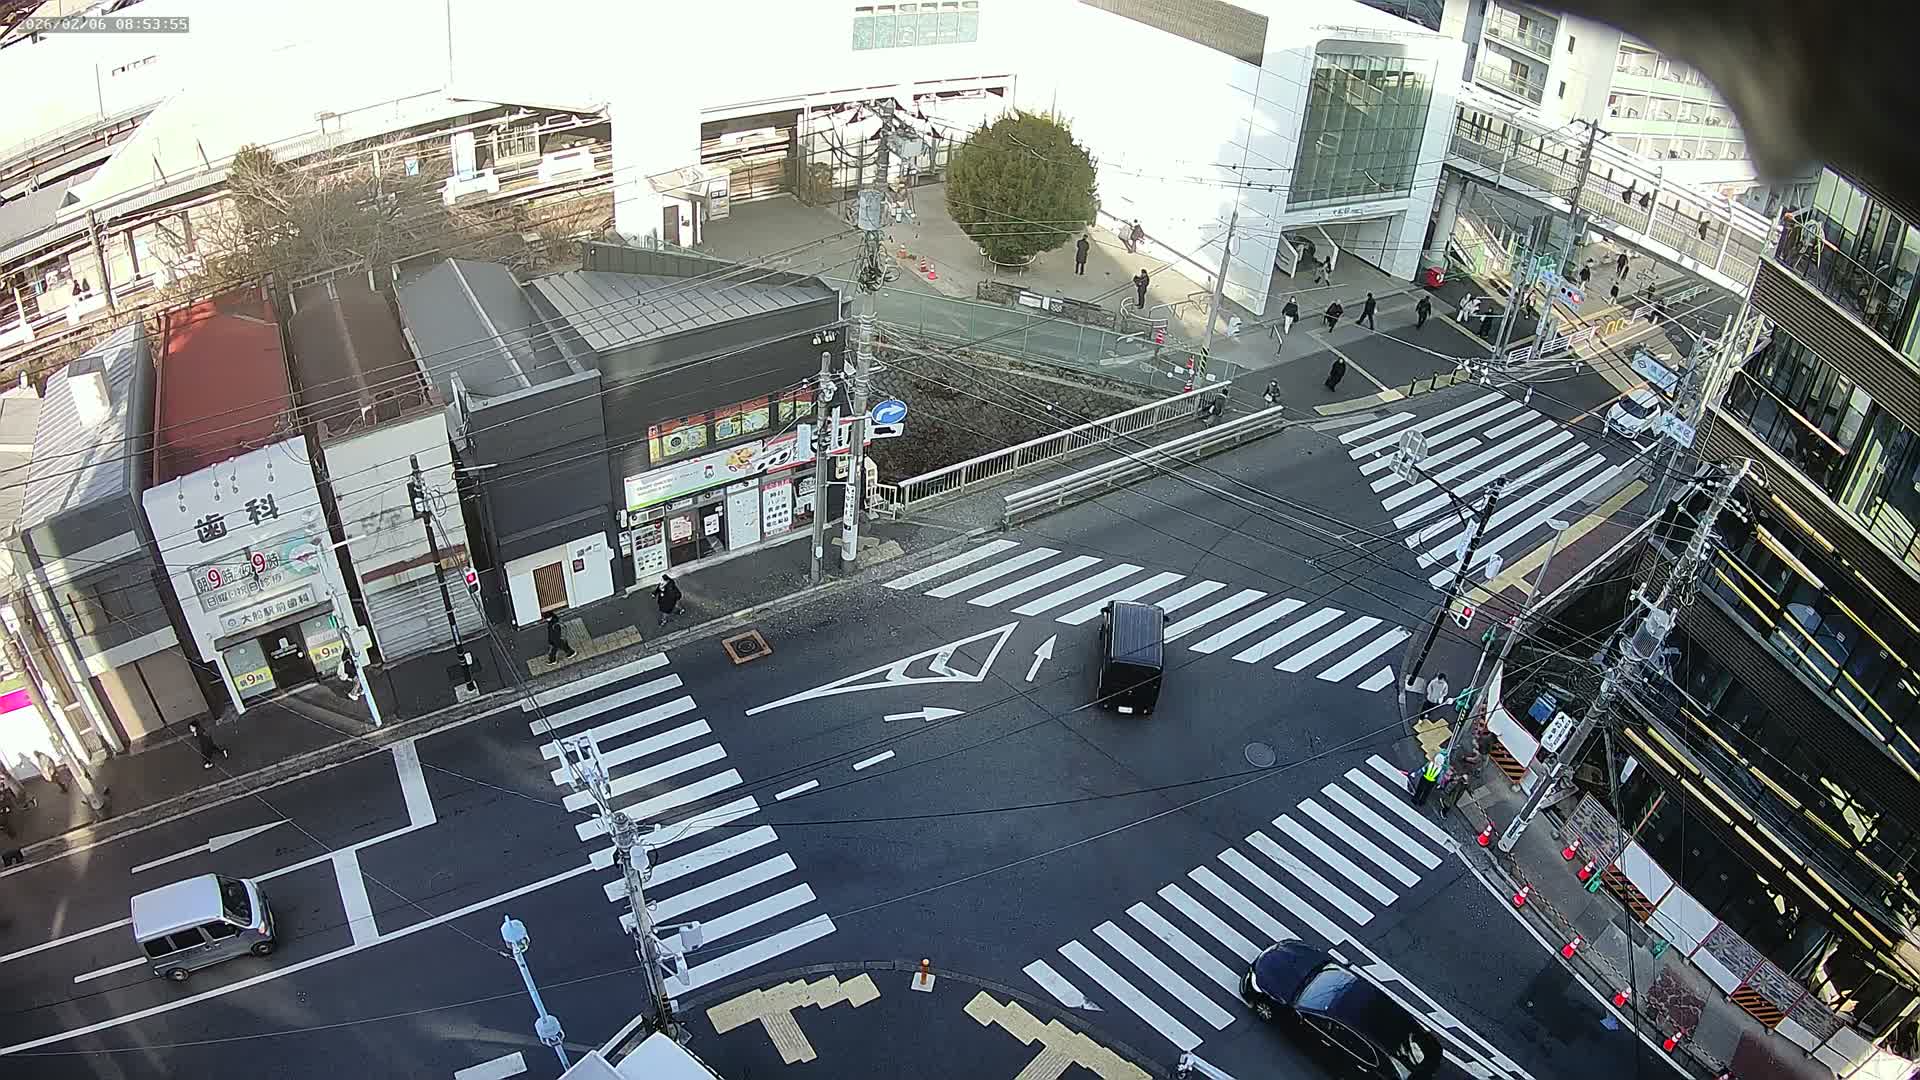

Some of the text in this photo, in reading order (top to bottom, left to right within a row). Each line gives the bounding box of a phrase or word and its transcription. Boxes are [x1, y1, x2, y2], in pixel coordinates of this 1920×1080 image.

[194, 493, 279, 543] 歯科
[241, 592, 310, 625] 大船駅前歯科
